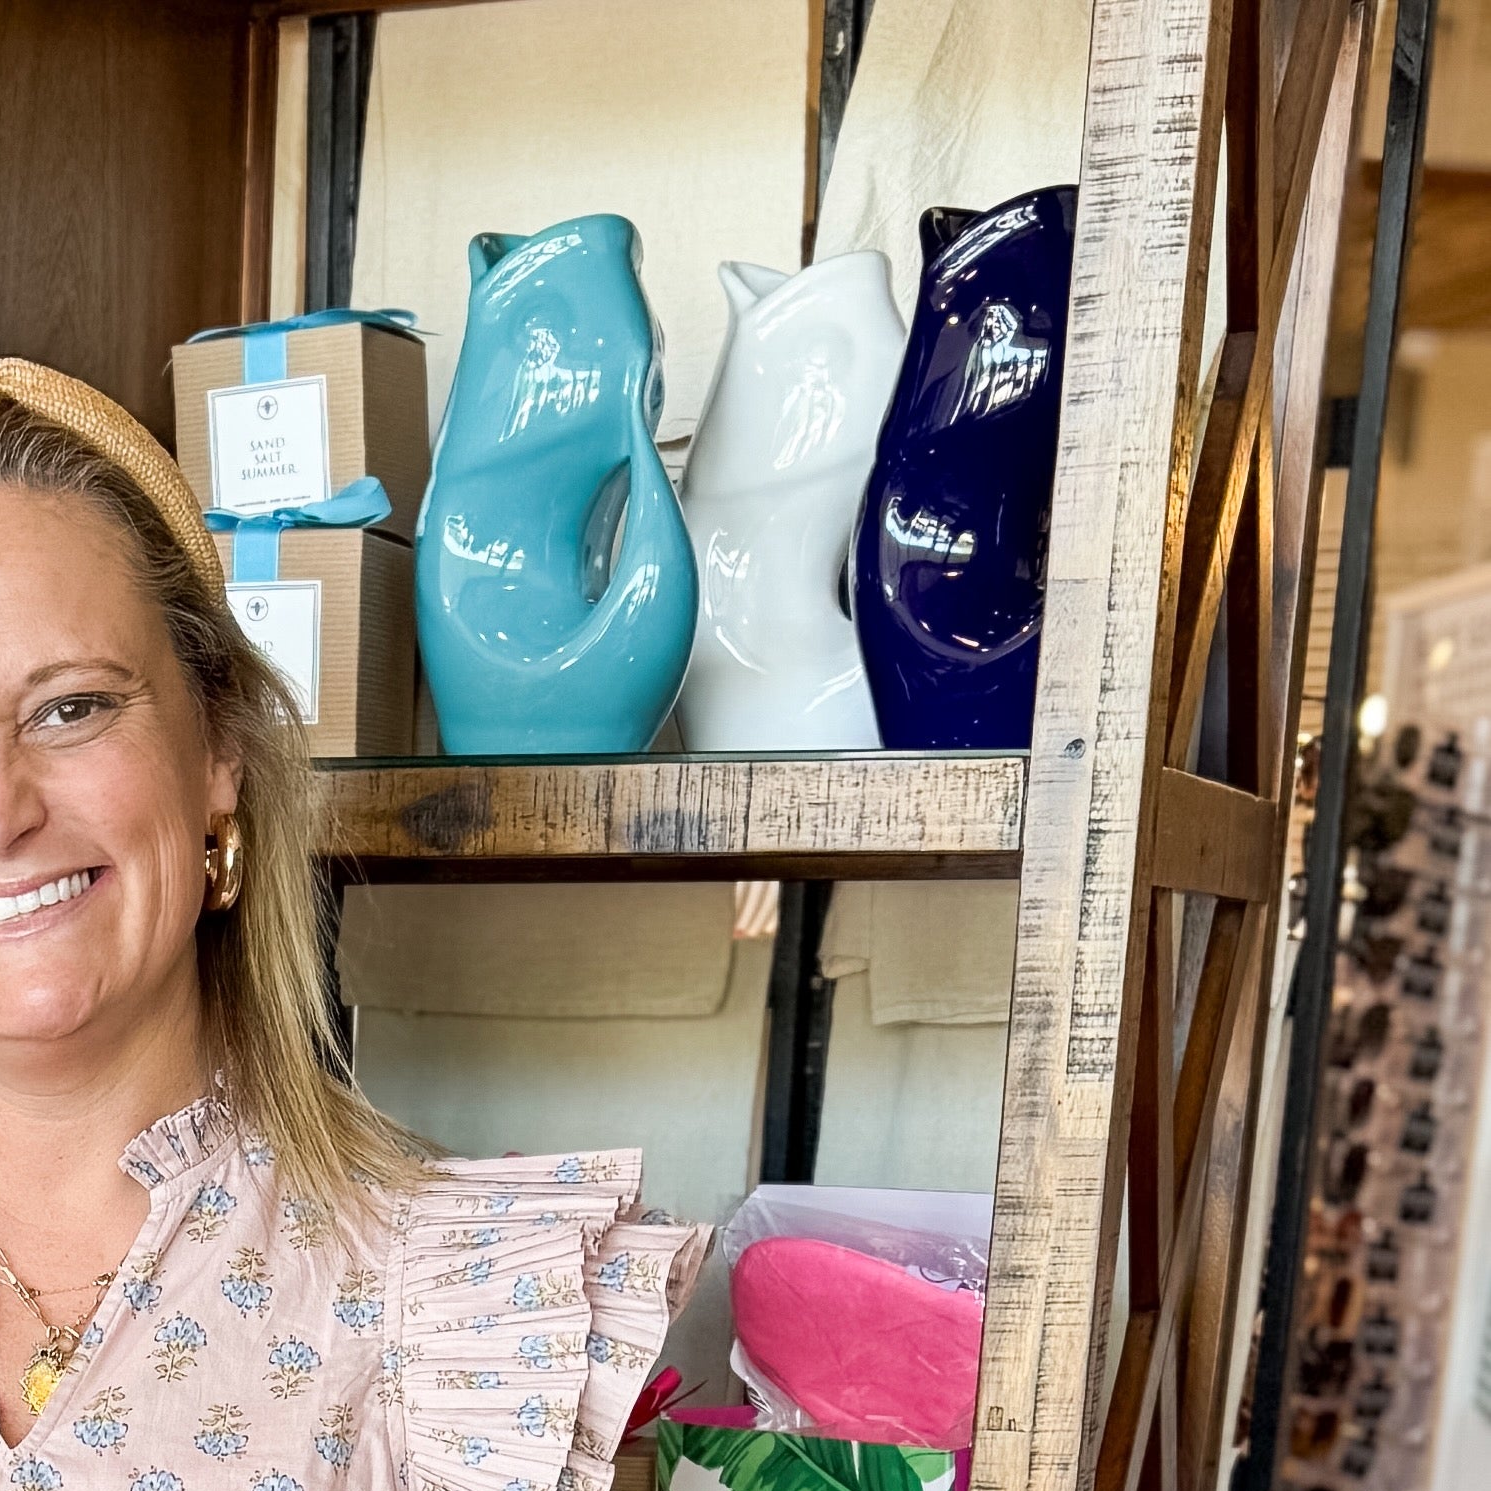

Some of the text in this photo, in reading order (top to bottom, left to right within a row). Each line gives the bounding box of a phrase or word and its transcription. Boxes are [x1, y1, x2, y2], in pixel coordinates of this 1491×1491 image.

[250, 437, 286, 451] SAND
[254, 451, 281, 464] SALT
[241, 464, 297, 480] SUMMER
